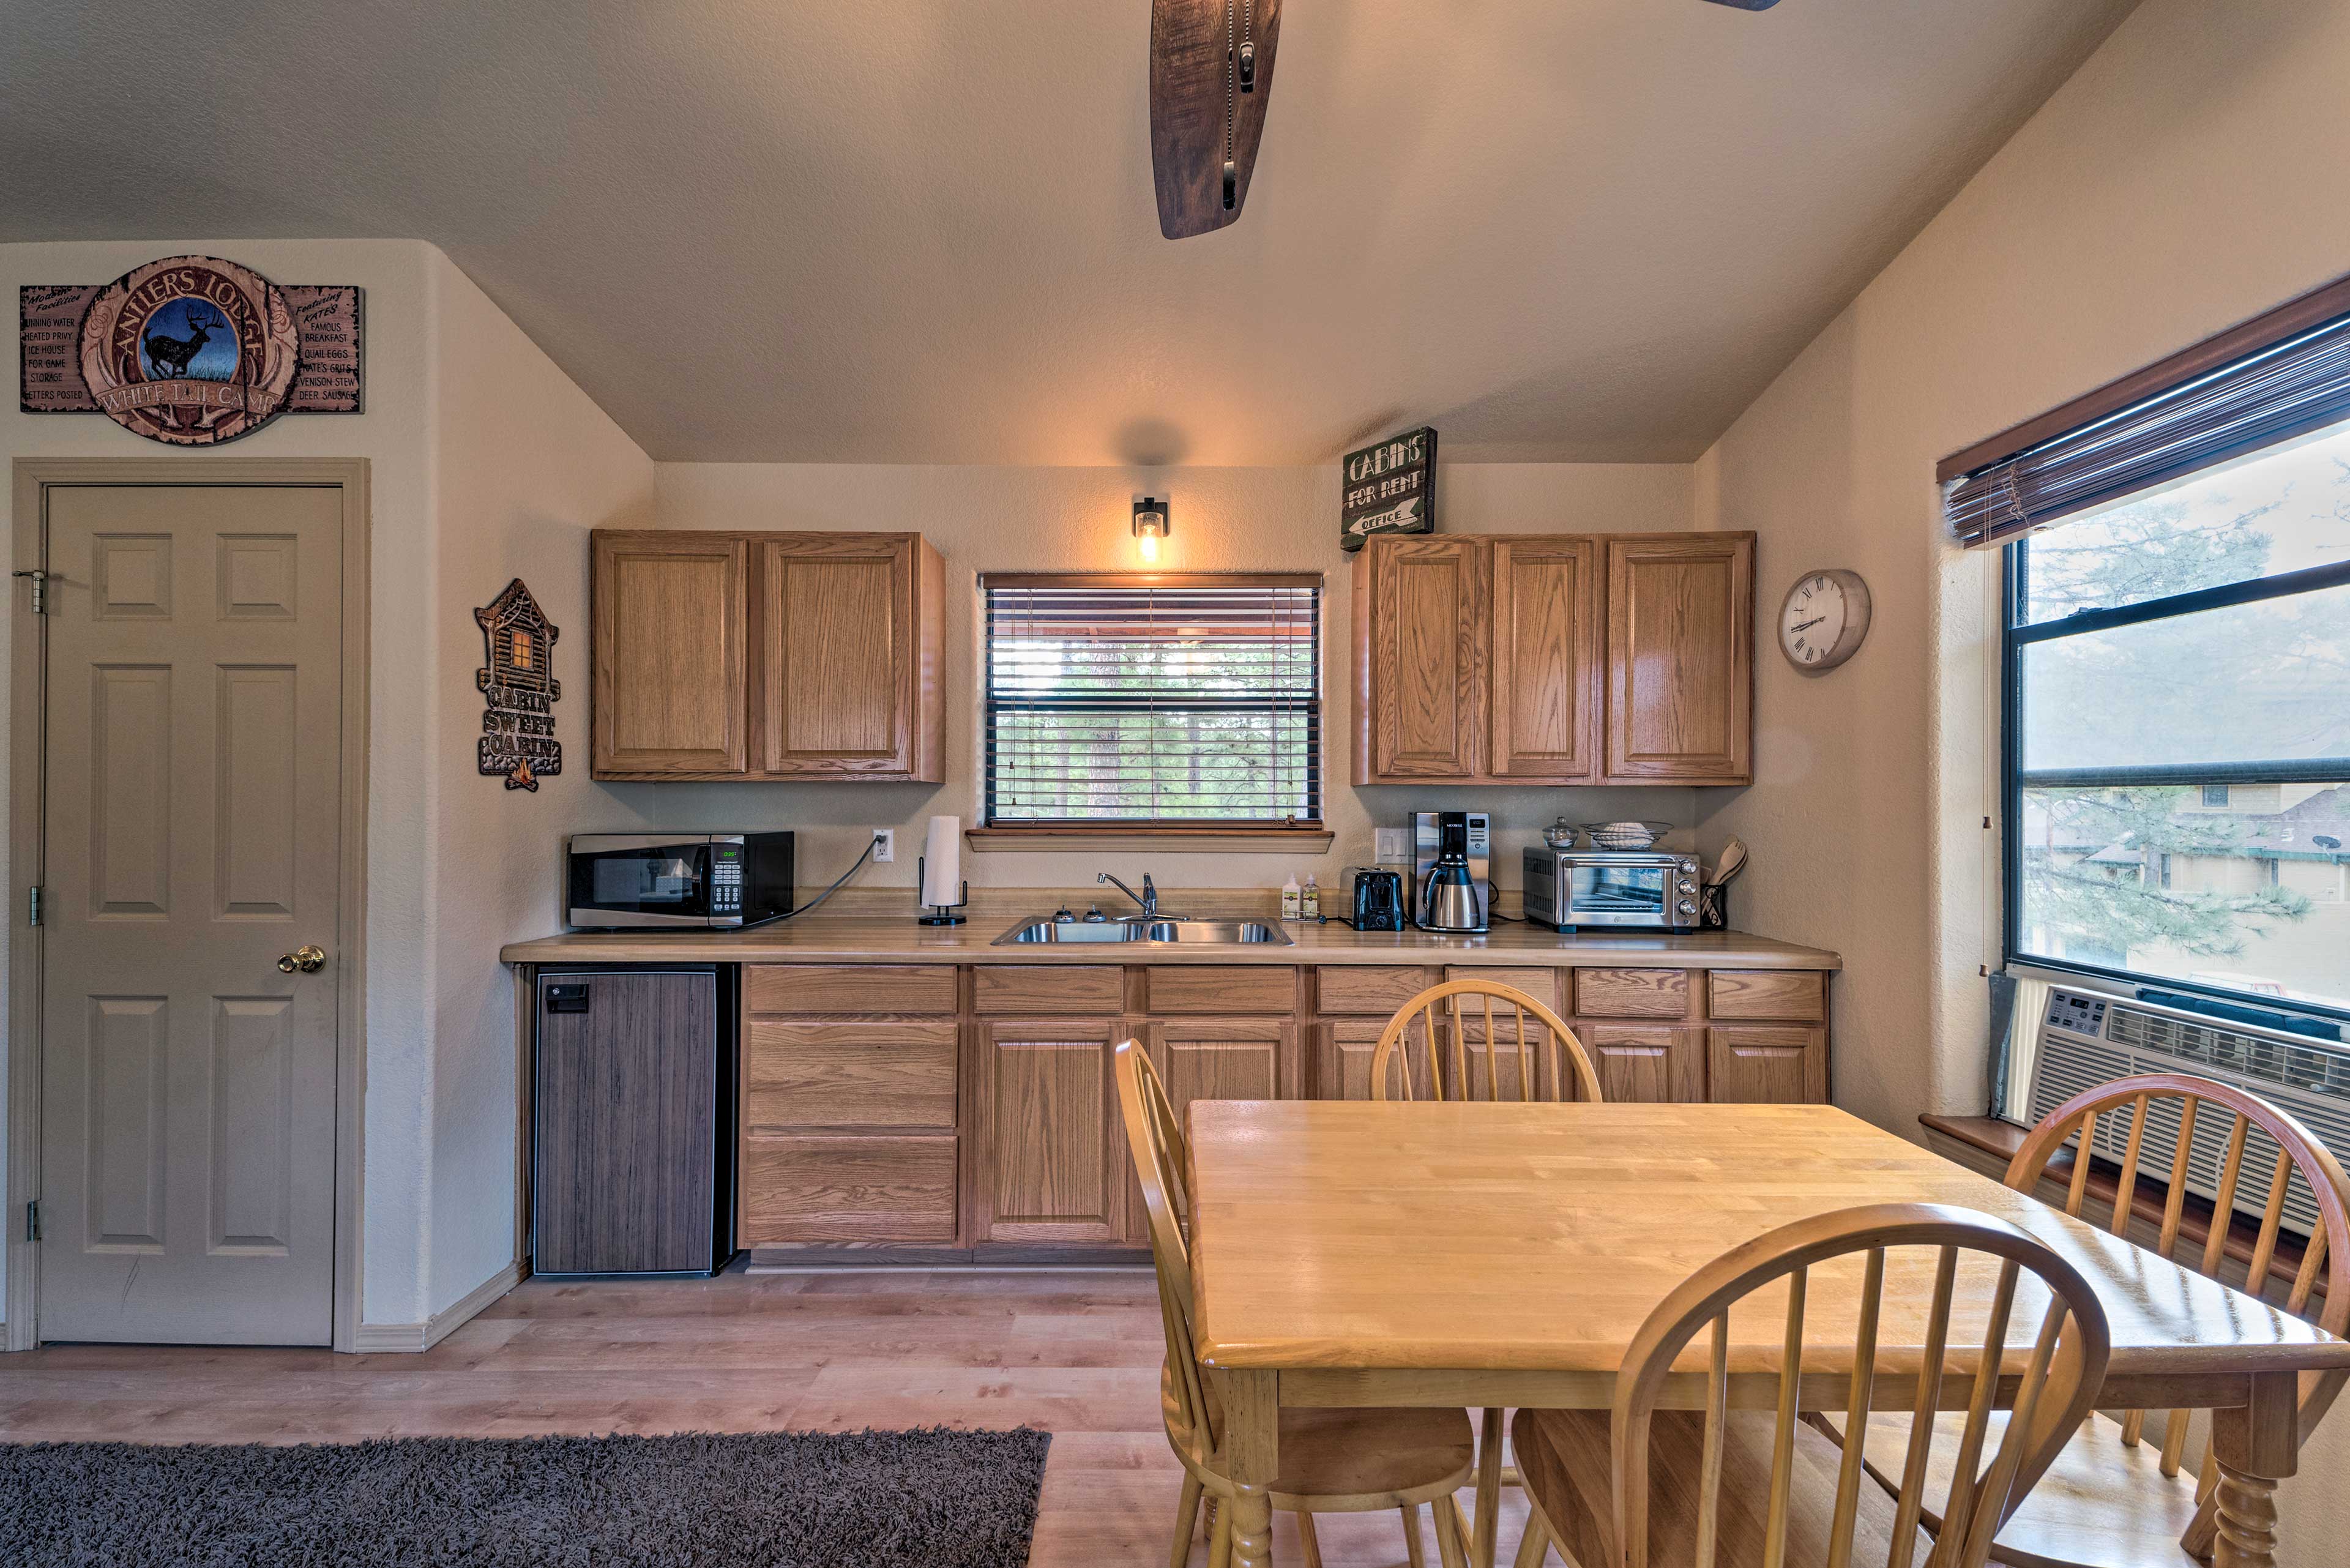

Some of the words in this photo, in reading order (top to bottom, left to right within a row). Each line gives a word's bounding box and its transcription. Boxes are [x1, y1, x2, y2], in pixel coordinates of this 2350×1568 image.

[28, 288, 67, 305] Modern
[36, 294, 81, 312] Facilities
[296, 291, 342, 315] Featuring
[116, 270, 195, 356] ANTLERS
[205, 275, 264, 356] LODGE
[304, 304, 338, 323] KATE'S
[26, 318, 51, 327] UNNING
[53, 318, 75, 327] WATER
[311, 323, 341, 332] FAMOUS
[24, 332, 50, 341] HEATED
[53, 332, 73, 340] PRIVY
[305, 334, 348, 343] BREAKFAST
[28, 346, 39, 354] ICE
[42, 346, 65, 354] HOUSE
[305, 349, 326, 359] QUAIL
[327, 349, 348, 359] EGGS
[28, 359, 43, 368] FOR
[45, 359, 65, 368] GAME
[330, 364, 351, 373] GRITS
[30, 373, 62, 383] STORAGE
[300, 377, 332, 386] VENISON
[335, 377, 355, 386] STEW
[56, 390, 83, 400] POSTED
[102, 385, 165, 412] WHITE
[170, 383, 211, 403] TAIL
[218, 386, 276, 413] CAMP
[299, 390, 319, 400] DEER
[322, 390, 355, 400] SAUSAGE
[1349, 435, 1421, 481] CABINS
[1348, 486, 1376, 509] FOR
[1381, 470, 1420, 499] RENT
[1361, 510, 1401, 530] OFFICE
[488, 685, 551, 714] CABIN
[485, 709, 556, 736] SWEET
[490, 733, 553, 758] CABIN
